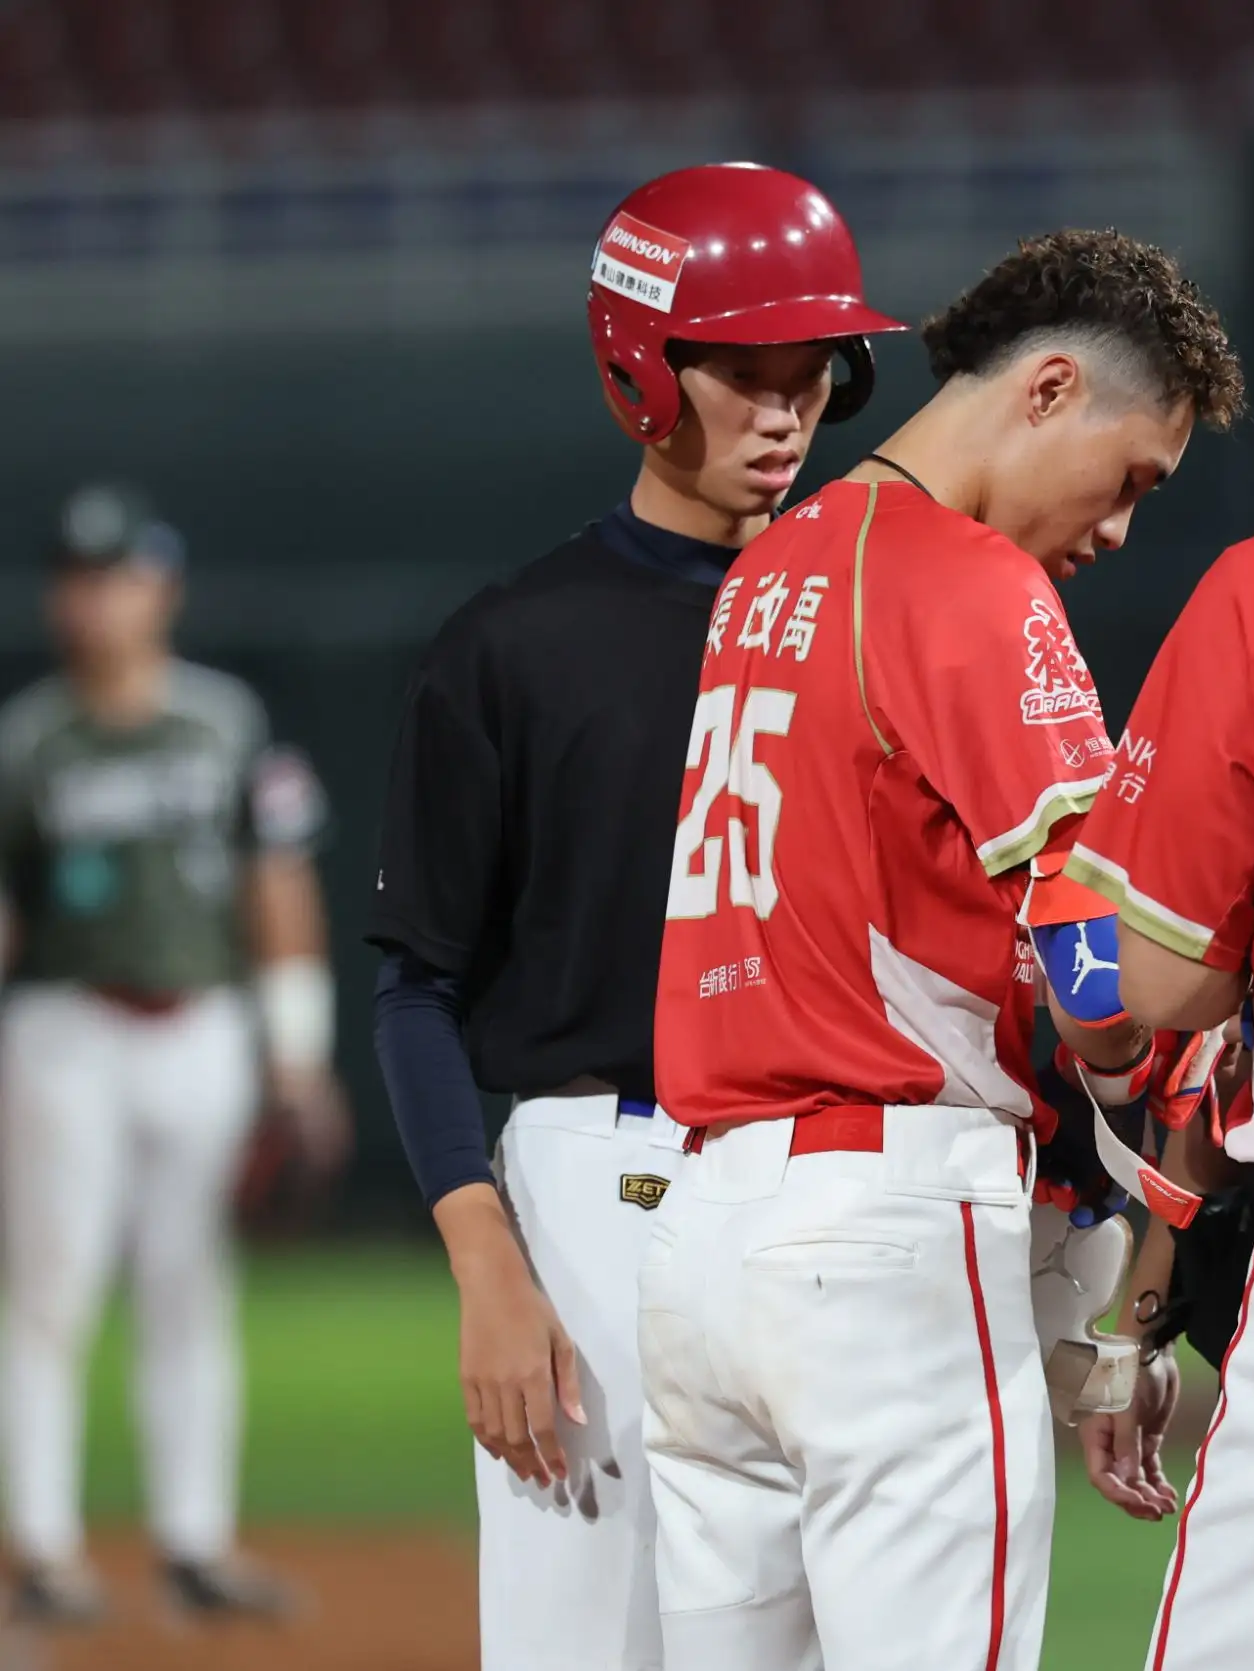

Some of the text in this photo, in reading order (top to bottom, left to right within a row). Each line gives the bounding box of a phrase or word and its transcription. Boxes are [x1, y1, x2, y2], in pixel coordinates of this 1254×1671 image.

[606, 226, 675, 265] JOHNSON
[665, 684, 798, 921] 25
[699, 963, 738, 999] 台新銀行
